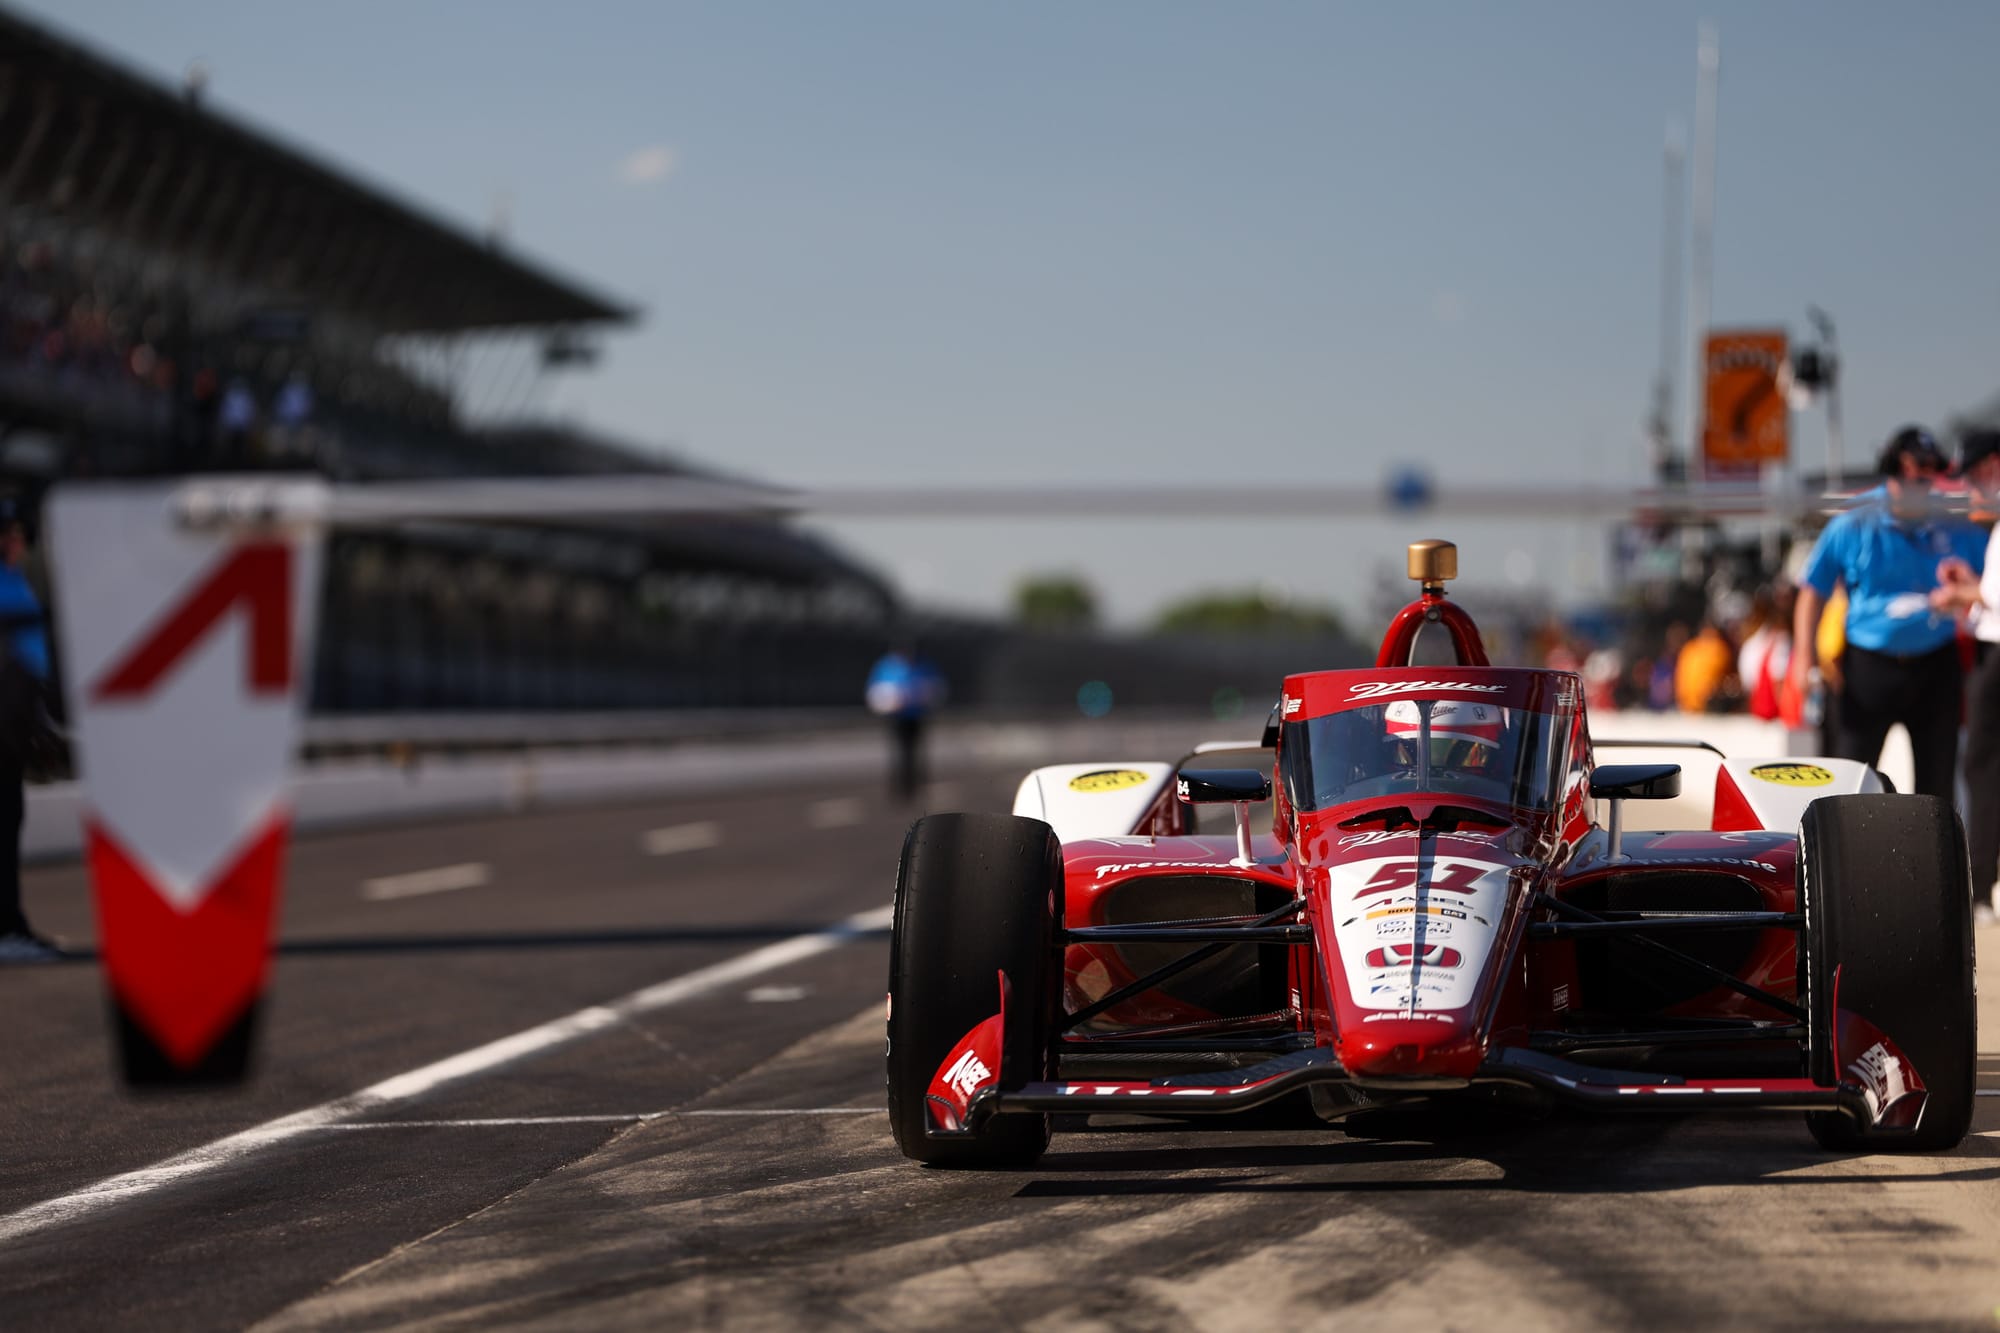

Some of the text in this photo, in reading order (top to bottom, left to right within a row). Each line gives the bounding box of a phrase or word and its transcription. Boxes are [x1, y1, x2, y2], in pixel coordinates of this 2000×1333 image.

[1344, 681, 1508, 703] Miller
[1095, 863, 1231, 880] Firestone
[1632, 856, 1777, 874] Firestone
[1352, 861, 1490, 901] 51
